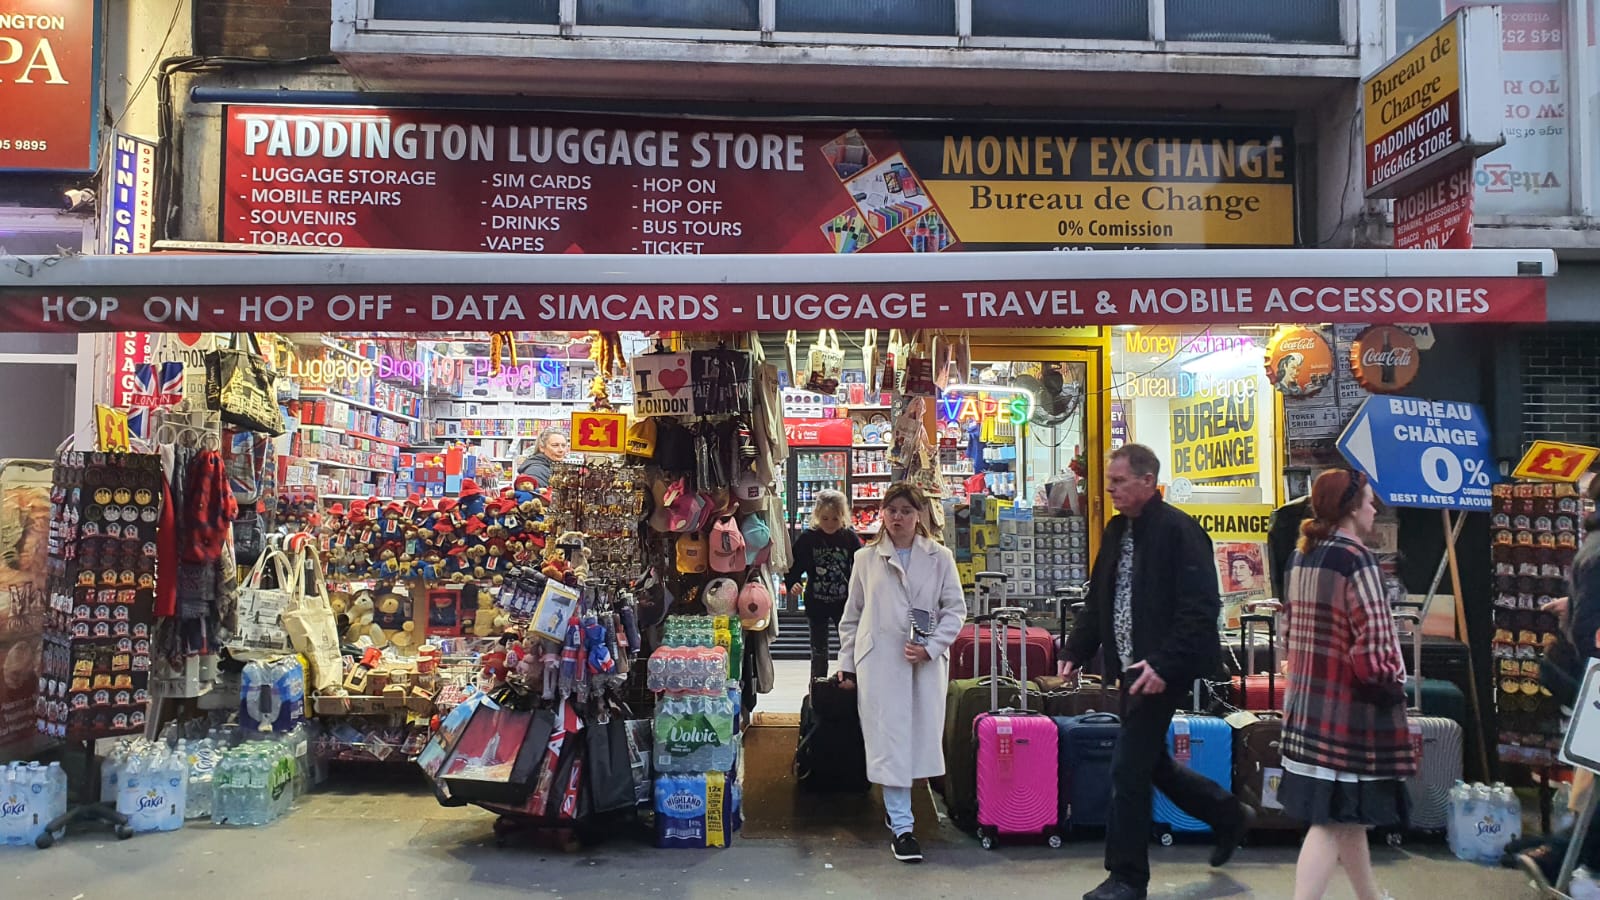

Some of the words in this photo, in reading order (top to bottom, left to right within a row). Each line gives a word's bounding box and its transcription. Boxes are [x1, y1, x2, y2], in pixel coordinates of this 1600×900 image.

[0, 38, 69, 85] PA
[1372, 55, 1425, 104] Bureau
[1430, 35, 1451, 63] de
[1529, 79, 1560, 95] TO
[1381, 76, 1441, 125] Change
[15, 139, 47, 151] 9895
[1374, 102, 1449, 163] PADDINGTON
[245, 119, 494, 162] PADDINGTON
[508, 125, 679, 168] LUGGAGE
[691, 131, 804, 172] STORE
[942, 135, 1078, 176] MONEY
[1090, 137, 1285, 179] EXCHANGE
[1372, 151, 1416, 186] LUGGAGE
[1418, 127, 1452, 161] STORE
[252, 168, 344, 185] LUGGAGE
[348, 170, 437, 187] STORAGE
[492, 174, 525, 189] SIM
[530, 174, 592, 191] CARDS
[643, 178, 683, 194] HOP
[687, 179, 716, 195] ON
[251, 188, 323, 205] MOBILE
[328, 190, 402, 207] REPAIRS
[492, 195, 588, 212] ADAPTERS
[643, 199, 683, 215] HOP
[687, 200, 723, 216] OFF
[969, 185, 1084, 211] Bureau
[1093, 185, 1131, 211] de
[1141, 186, 1260, 220] Change
[1397, 181, 1446, 224] MOBILE
[251, 210, 357, 227] SOUVENIRS
[492, 216, 561, 232] DRINKS
[643, 220, 678, 236] BUS
[682, 221, 742, 237] TOURS
[1058, 220, 1084, 238] 0%
[1088, 220, 1173, 238] Comission
[250, 230, 343, 248] TOBACCO
[642, 240, 704, 254] TICKET
[42, 296, 119, 322] HOP
[143, 296, 199, 322] ON
[239, 295, 314, 322] HOP
[327, 294, 392, 321] OFF
[431, 294, 526, 320] DATA
[538, 293, 719, 321] SIMCARDS
[757, 292, 926, 321] LUGGAGE
[962, 290, 1084, 317] TRAVEL
[1094, 289, 1117, 315] &
[1128, 287, 1254, 314] MOBILE
[1264, 285, 1490, 313] ACCESSORIES
[1126, 331, 1178, 358] Money
[286, 355, 374, 384] Luggage
[378, 355, 424, 387] Drop
[431, 356, 464, 386] 191
[540, 356, 563, 389] St
[636, 369, 651, 399] I
[1126, 371, 1177, 398] Bureau
[1199, 371, 1256, 404] Change
[637, 397, 689, 414] LONDON
[943, 396, 1026, 425] VAPES
[1389, 399, 1472, 421] BUREAU
[1173, 394, 1255, 445] BUREAU
[1426, 418, 1442, 427] DE
[578, 416, 619, 449] £1
[1393, 424, 1479, 447] CHANGE
[1175, 446, 1191, 473] DE
[1194, 435, 1255, 472] CHANGE
[1526, 447, 1588, 478] £1
[1421, 446, 1490, 495] 0%
[1389, 492, 1417, 503] BEST
[1421, 494, 1455, 506] RATES
[670, 726, 717, 743] Volvic
[665, 794, 702, 808] HIGHLAND
